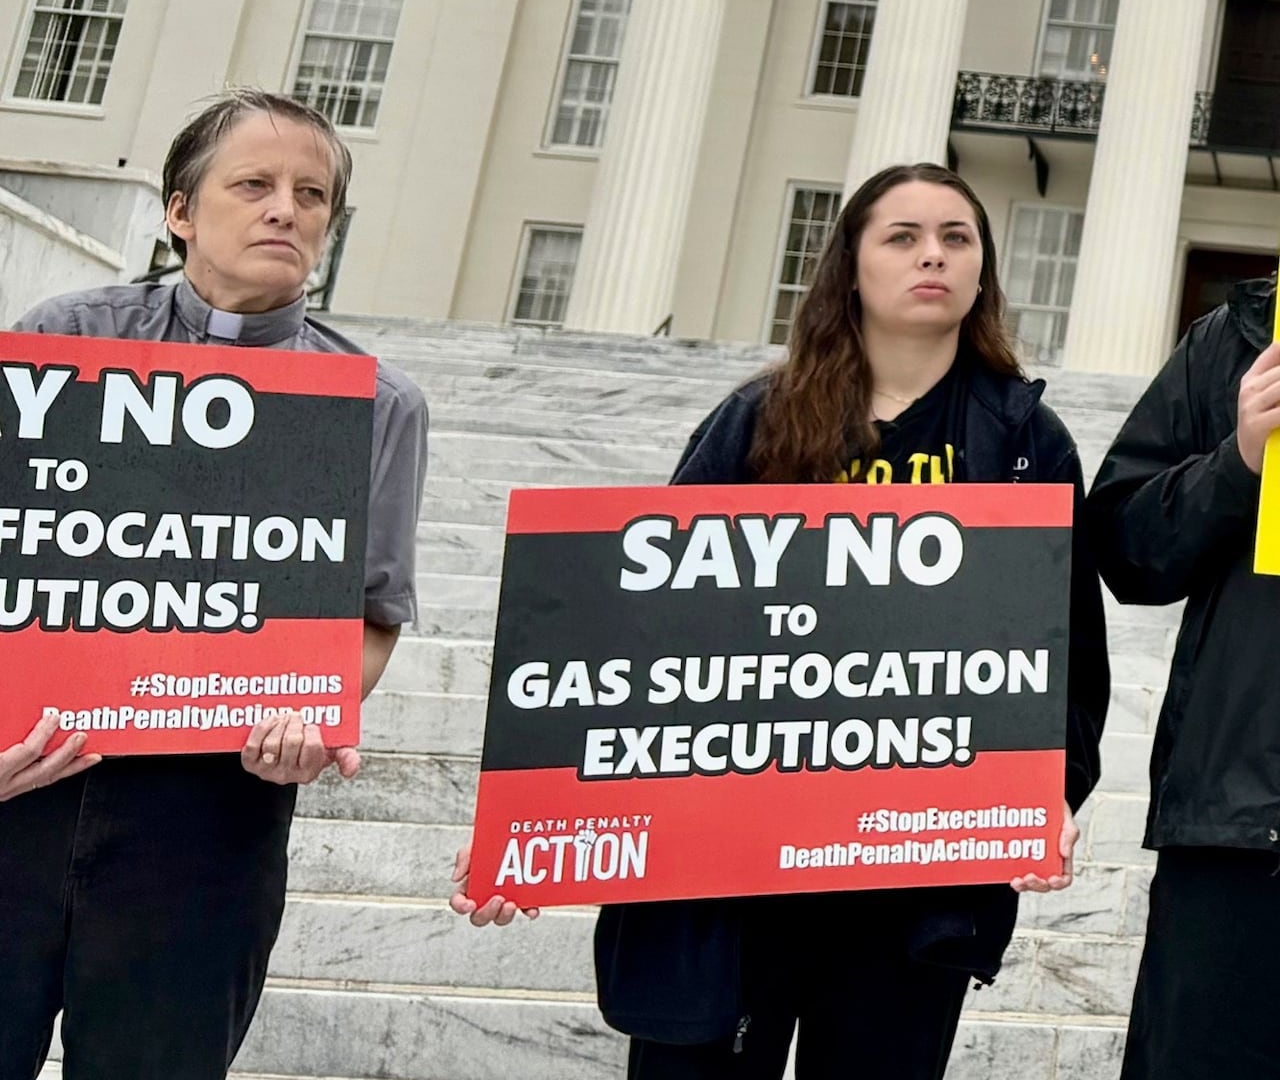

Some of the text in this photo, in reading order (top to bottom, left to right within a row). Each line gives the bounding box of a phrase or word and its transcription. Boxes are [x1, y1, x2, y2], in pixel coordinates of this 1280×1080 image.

[0, 366, 255, 449] Y NO
[28, 457, 89, 492] TO
[619, 515, 964, 591] SAY NO
[0, 578, 260, 629] UTIONS!
[763, 604, 817, 637] TO
[130, 673, 342, 698] #StopExecutions
[507, 648, 1049, 709] GAS SUFFOCATION
[582, 716, 973, 776] EXECUTIONS!
[510, 815, 652, 833] DEATH PENALTY
[857, 805, 1046, 833] #StopExecutions
[494, 831, 648, 886] ACTION
[779, 837, 1045, 869] DeathPenaltyAction.org
